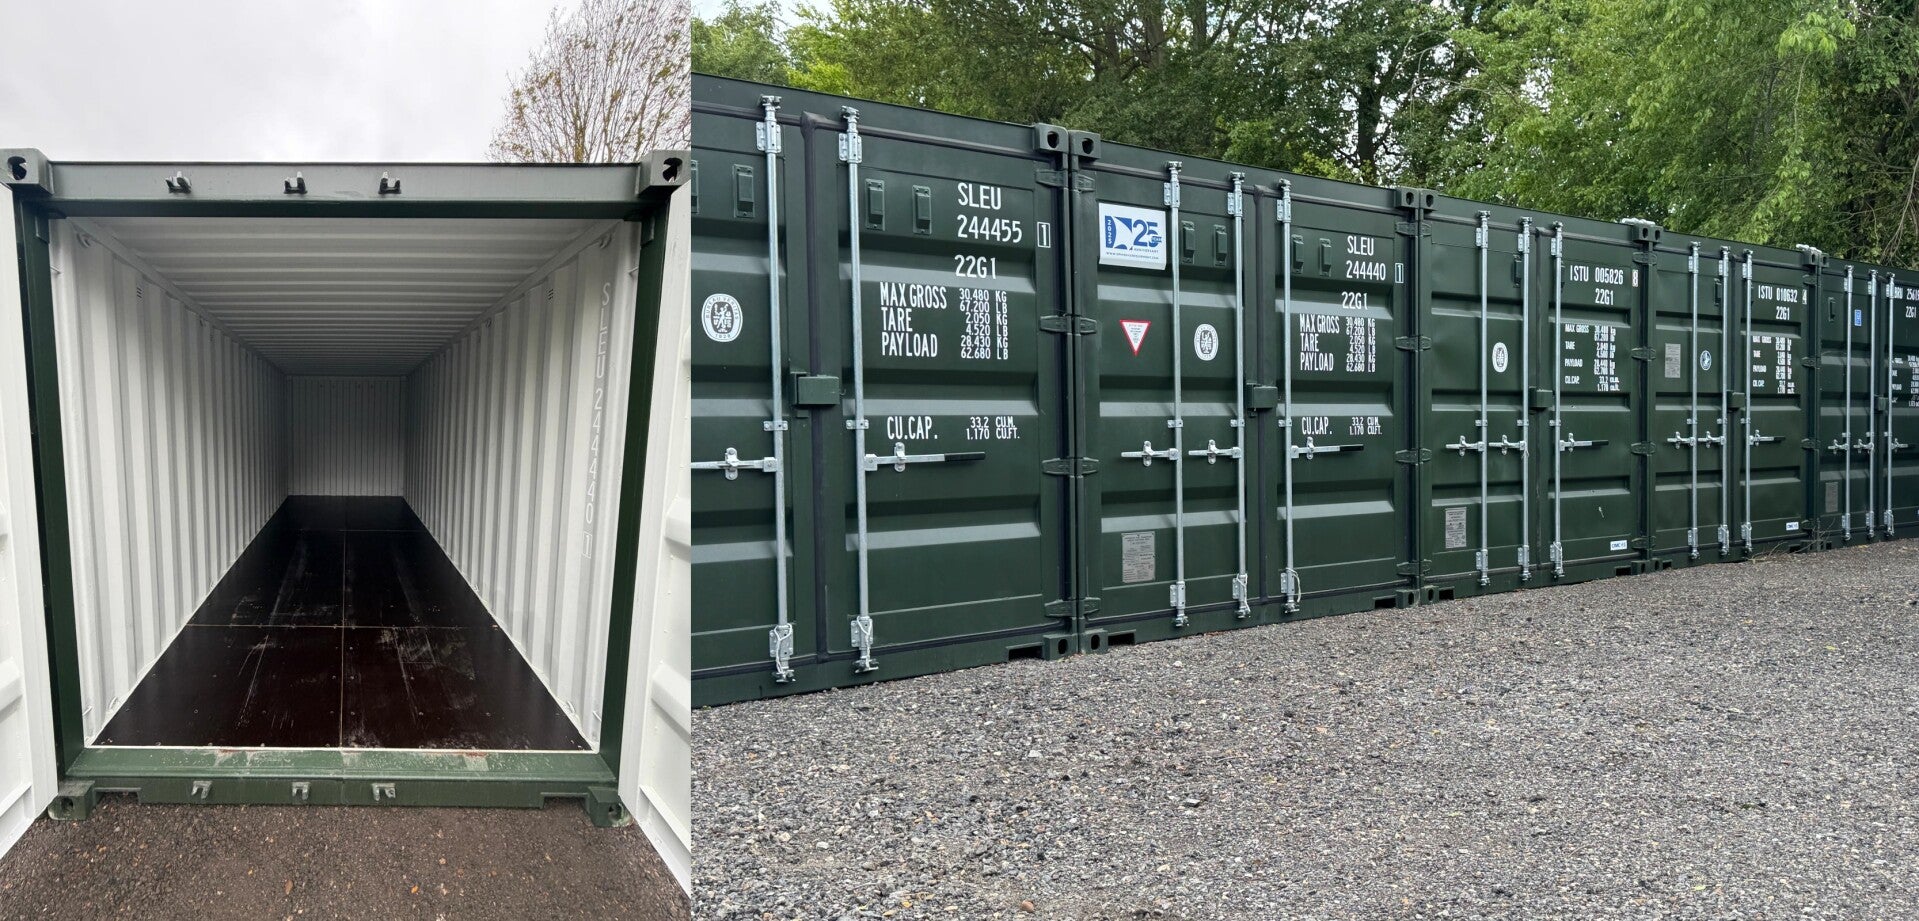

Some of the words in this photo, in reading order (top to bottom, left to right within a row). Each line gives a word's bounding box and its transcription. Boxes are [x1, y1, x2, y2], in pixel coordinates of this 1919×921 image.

[958, 183, 1001, 210] SLEU
[957, 215, 1022, 243] 244455
[1133, 219, 1158, 247] 25
[1347, 235, 1374, 255] SLEU
[955, 255, 996, 279] 22G1
[1346, 260, 1386, 280] 244440
[1570, 265, 1589, 282] ISTU
[1595, 267, 1623, 284] 005826
[880, 282, 905, 306] MAX
[910, 285, 947, 309] GROSS
[959, 288, 989, 301] 30.480
[996, 291, 1007, 302] KG
[1342, 292, 1368, 310] 22G1
[1595, 288, 1613, 305] 22G1
[1759, 285, 1772, 299] ISTU
[960, 301, 990, 313] 67.200
[996, 303, 1007, 314] LB
[1776, 306, 1789, 320] 22G1
[881, 307, 912, 332] TARE
[966, 313, 990, 324] 2.050
[996, 314, 1008, 325] KG
[1300, 313, 1315, 332] MAX
[1317, 315, 1339, 334] GROSS
[1368, 318, 1375, 327] KG
[966, 324, 990, 336] 4.520
[997, 325, 1008, 337] LB
[1368, 327, 1375, 336] LB
[882, 332, 937, 357] PAYLOAD
[960, 336, 990, 348] 28.430
[997, 337, 1008, 348] KG
[1300, 333, 1319, 352] TARE
[1368, 336, 1375, 345] KG
[960, 348, 990, 359] 62.680
[997, 349, 1008, 360] LB
[1300, 352, 1334, 371] PAYLOAD
[1368, 354, 1375, 363] KG
[1368, 363, 1375, 372] LB
[887, 416, 937, 440] CU.CAP.
[970, 417, 989, 429] 33.2
[967, 428, 990, 440] 1.170
[1302, 417, 1332, 435] CU.CAP.
